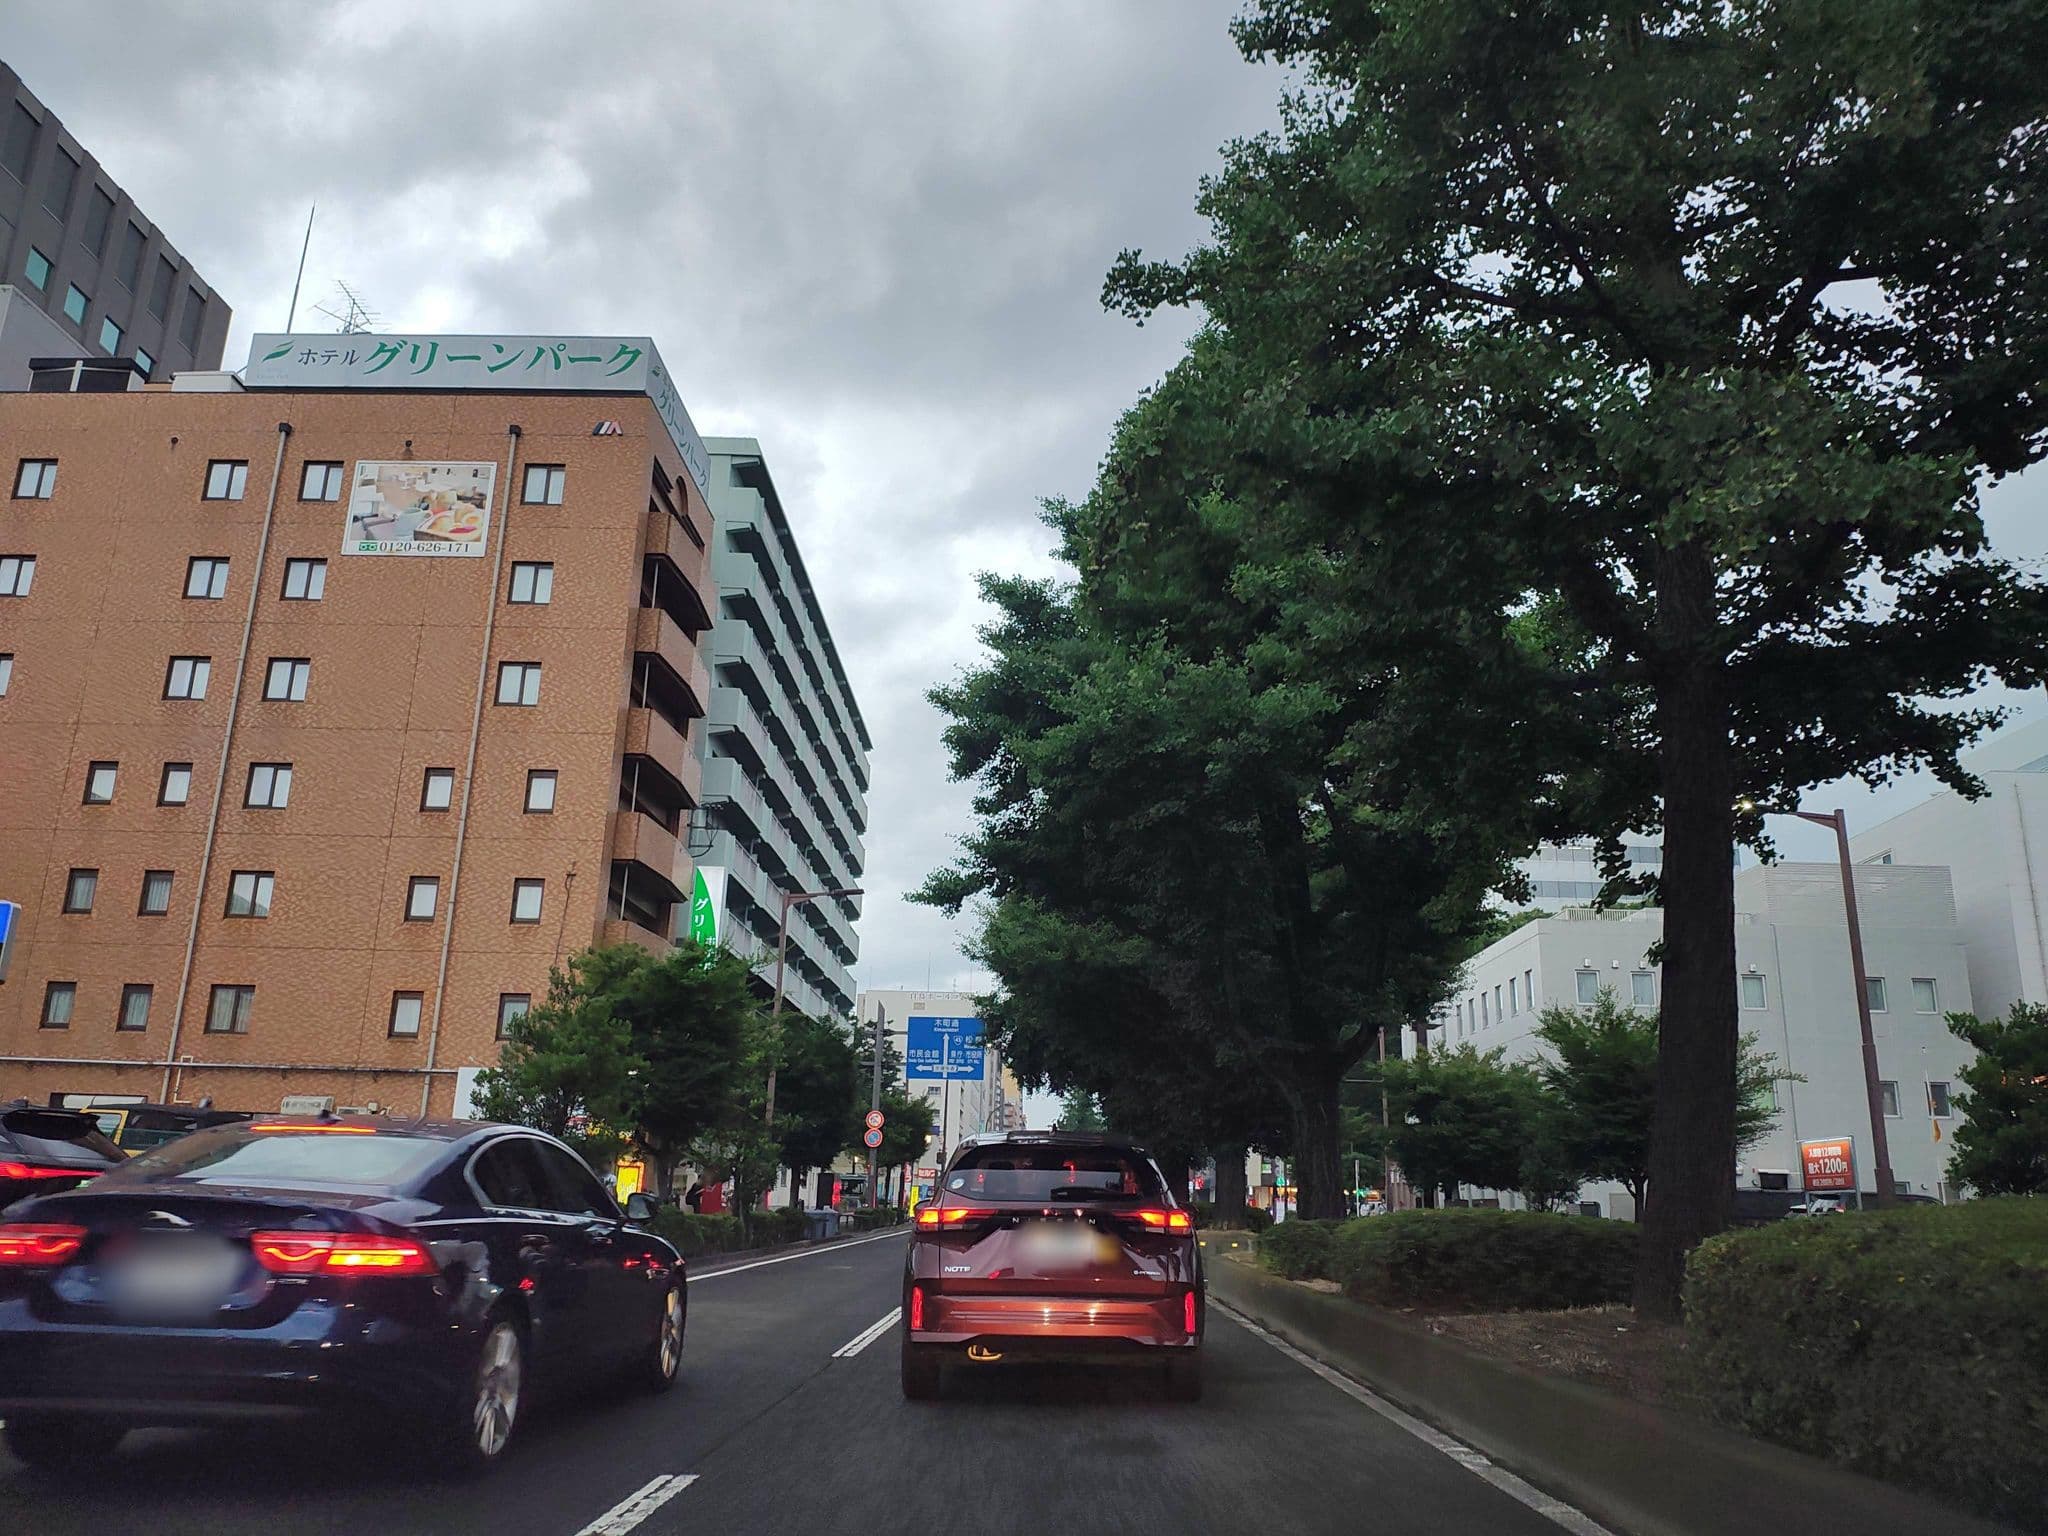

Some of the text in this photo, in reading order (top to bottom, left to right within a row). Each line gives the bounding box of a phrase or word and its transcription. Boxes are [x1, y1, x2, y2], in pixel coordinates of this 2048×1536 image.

[298, 339, 644, 377] ホテル グリーンパーク
[379, 541, 470, 553] 0120-626-171
[944, 1265, 971, 1273] NOTE
